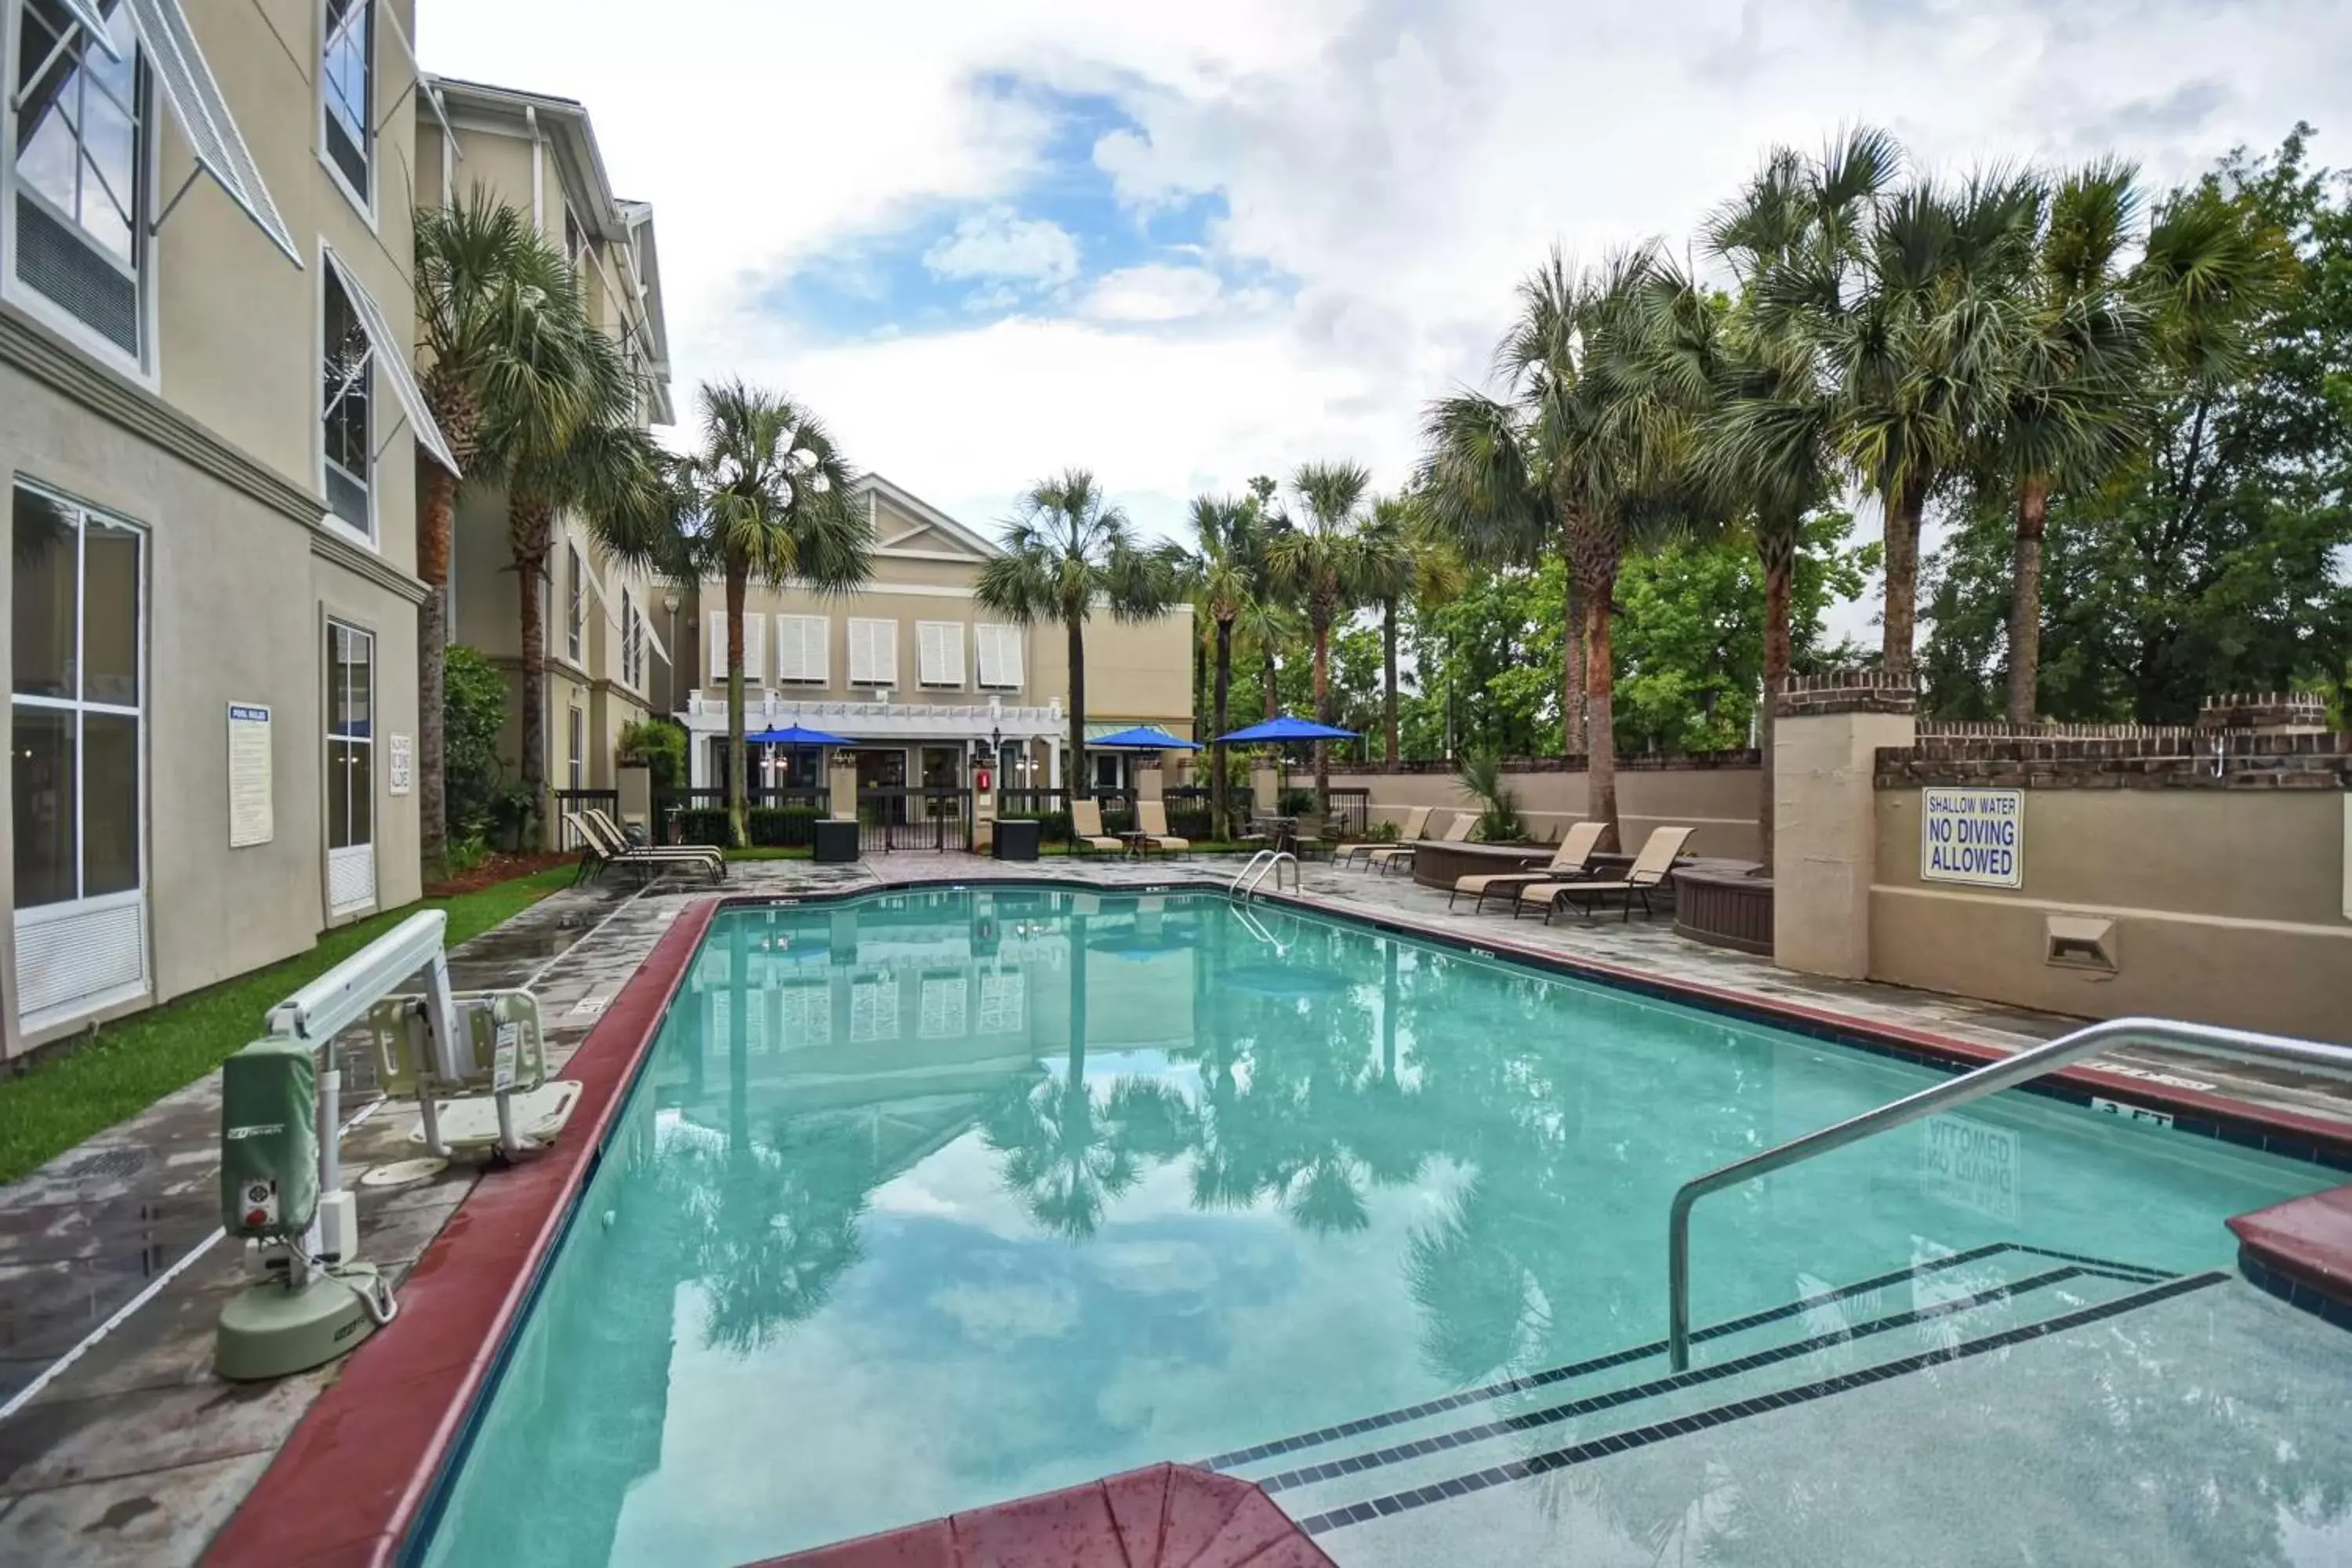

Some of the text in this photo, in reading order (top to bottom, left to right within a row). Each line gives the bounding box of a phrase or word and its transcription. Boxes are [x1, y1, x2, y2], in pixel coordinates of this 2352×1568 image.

[1929, 796, 2016, 815] SHALLOW WATER
[1929, 818, 2014, 846] NO DIVING
[1931, 846, 2013, 875] ALLOWED
[2103, 1103, 2171, 1126] 3 FT
